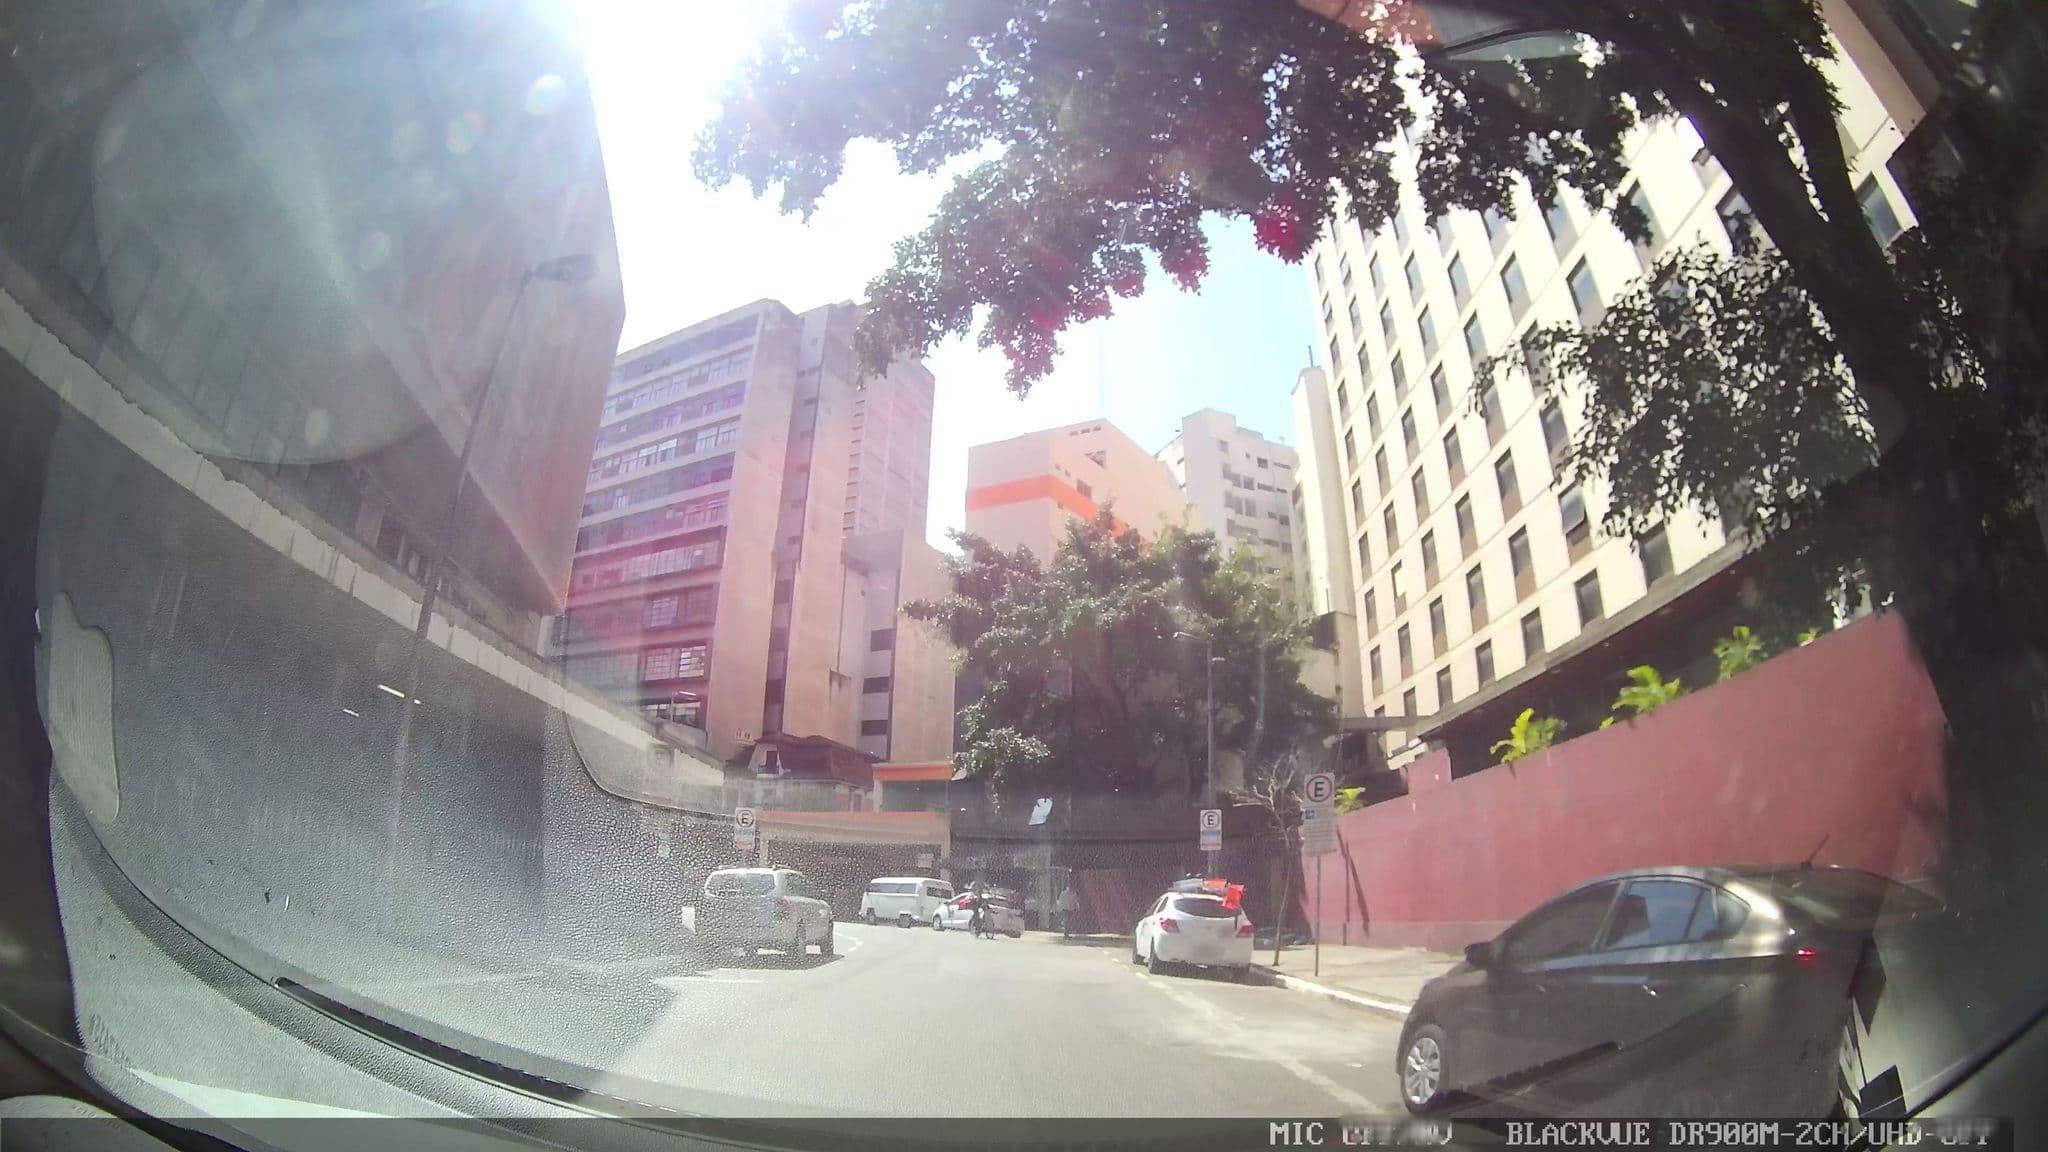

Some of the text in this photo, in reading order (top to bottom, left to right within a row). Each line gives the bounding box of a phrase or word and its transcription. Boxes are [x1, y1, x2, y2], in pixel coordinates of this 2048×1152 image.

[1314, 781, 1325, 797] E
[741, 813, 749, 824] E
[1207, 814, 1215, 825] E
